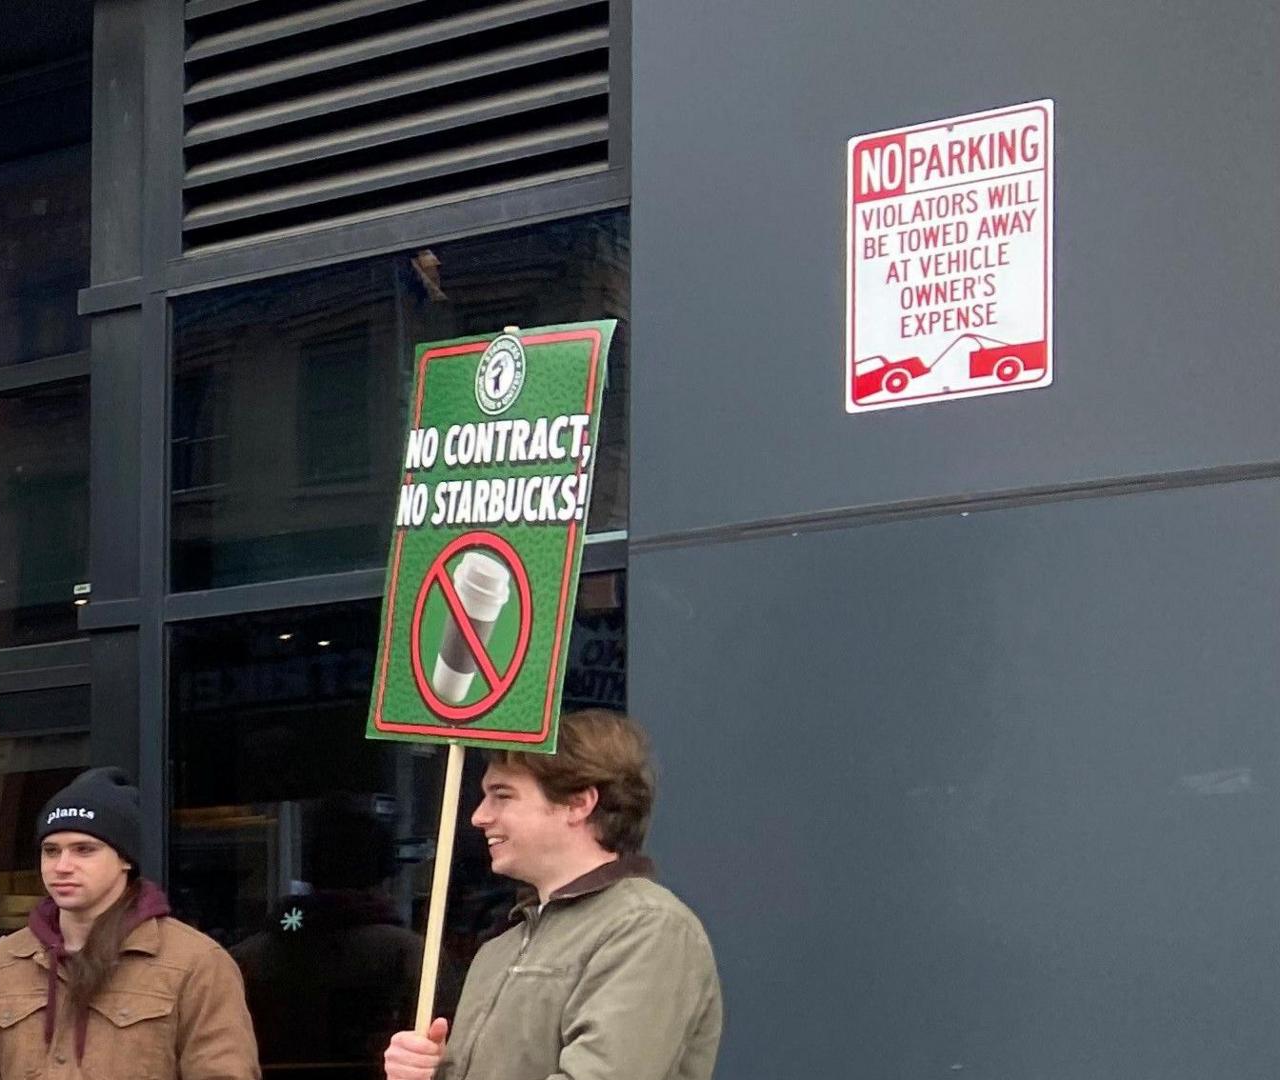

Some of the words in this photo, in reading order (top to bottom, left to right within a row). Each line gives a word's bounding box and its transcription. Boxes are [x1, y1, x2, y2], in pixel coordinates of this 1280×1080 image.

[860, 143, 903, 195] NO
[910, 125, 1040, 184] PARKING
[862, 190, 979, 231] VIOLATORS
[988, 181, 1040, 210] WILL
[864, 237, 889, 260] BE
[898, 221, 968, 254] TOWED
[977, 208, 1037, 241] AWAY
[886, 259, 910, 285] AT
[919, 243, 1010, 279] VEHICLE
[901, 274, 996, 310] OWNER'S
[901, 302, 998, 338] EXPENSE
[406, 427, 438, 469] NO
[444, 415, 591, 467] CONTRACT,
[397, 483, 427, 526] NO
[430, 473, 588, 525] STARBUCKS!
[47, 808, 95, 824] plants
